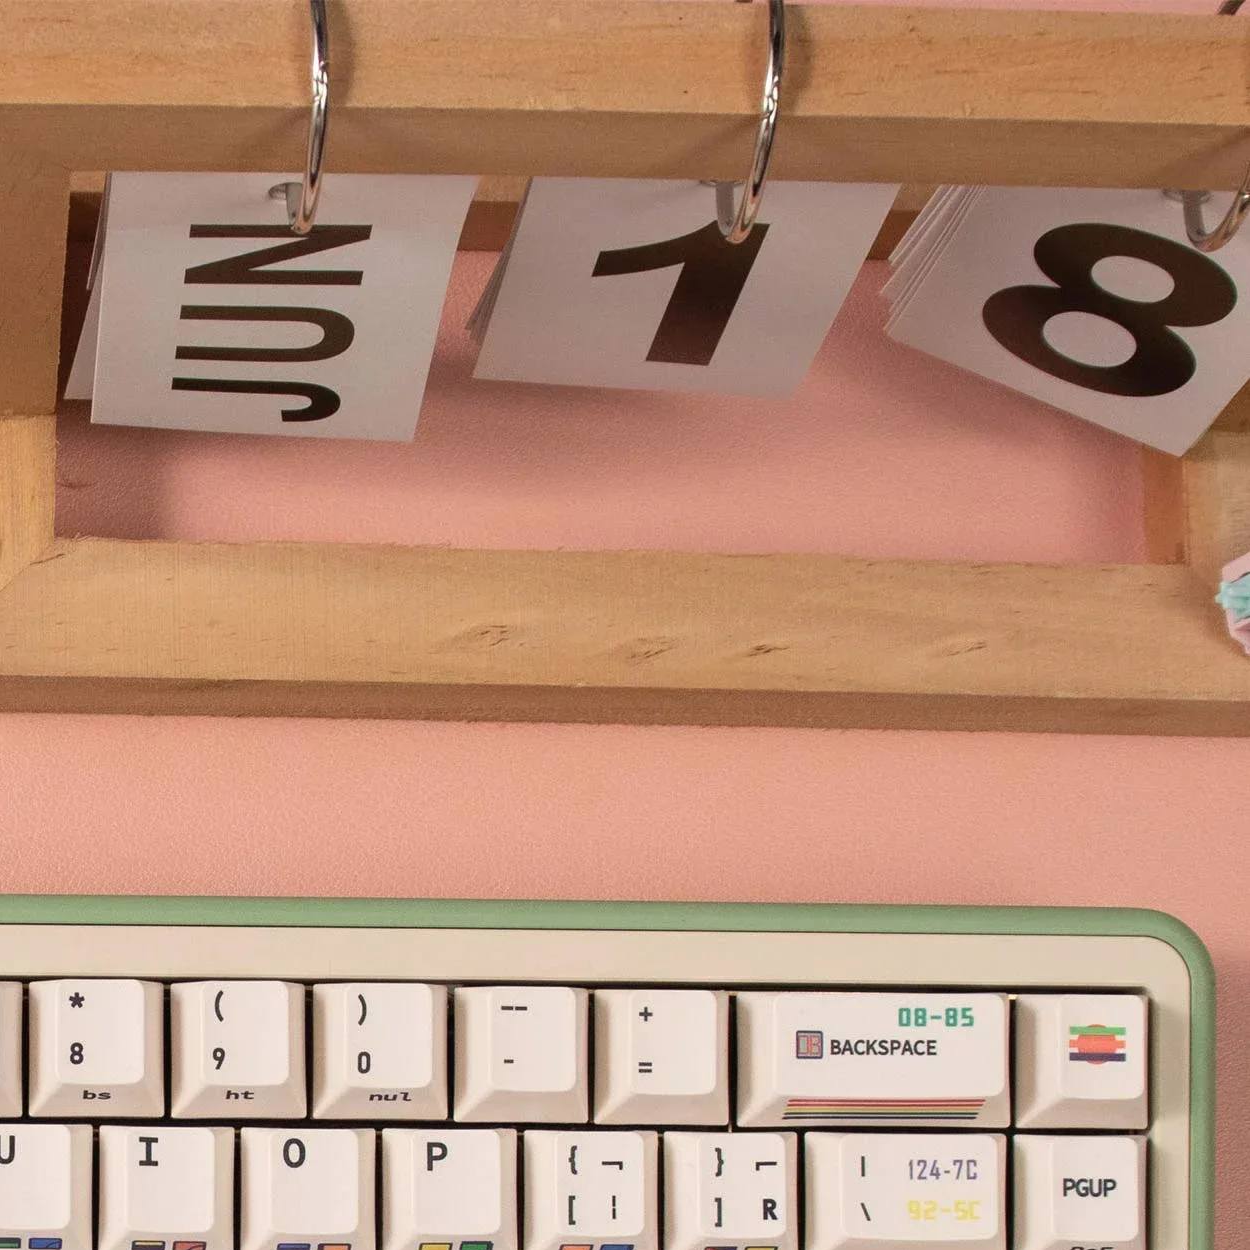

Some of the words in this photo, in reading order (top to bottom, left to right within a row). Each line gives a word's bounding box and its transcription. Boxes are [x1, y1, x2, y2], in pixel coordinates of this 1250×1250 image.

[592, 220, 770, 366] 1
[982, 222, 1237, 397] 8
[172, 224, 372, 422] JUN
[214, 989, 224, 1023] (
[357, 993, 368, 1026] )
[638, 1006, 654, 1023] +
[898, 1007, 975, 1028] 08-85
[69, 1041, 84, 1065] 8
[212, 1047, 226, 1071] 9
[830, 1039, 938, 1056] BACKSPACE
[357, 1051, 371, 1075] 0
[638, 1061, 653, 1074] =
[82, 1089, 112, 1100] bs
[225, 1089, 255, 1100] ht
[368, 1091, 412, 1102] nul
[138, 1136, 159, 1167] I
[282, 1137, 307, 1169] O
[426, 1141, 448, 1172] P
[568, 1145, 578, 1176] {
[714, 1147, 725, 1178] }
[908, 1158, 978, 1181] 124-7C
[1062, 1177, 1117, 1198] PGUP
[567, 1194, 577, 1226] [
[714, 1197, 723, 1228] ]
[762, 1198, 779, 1221] R
